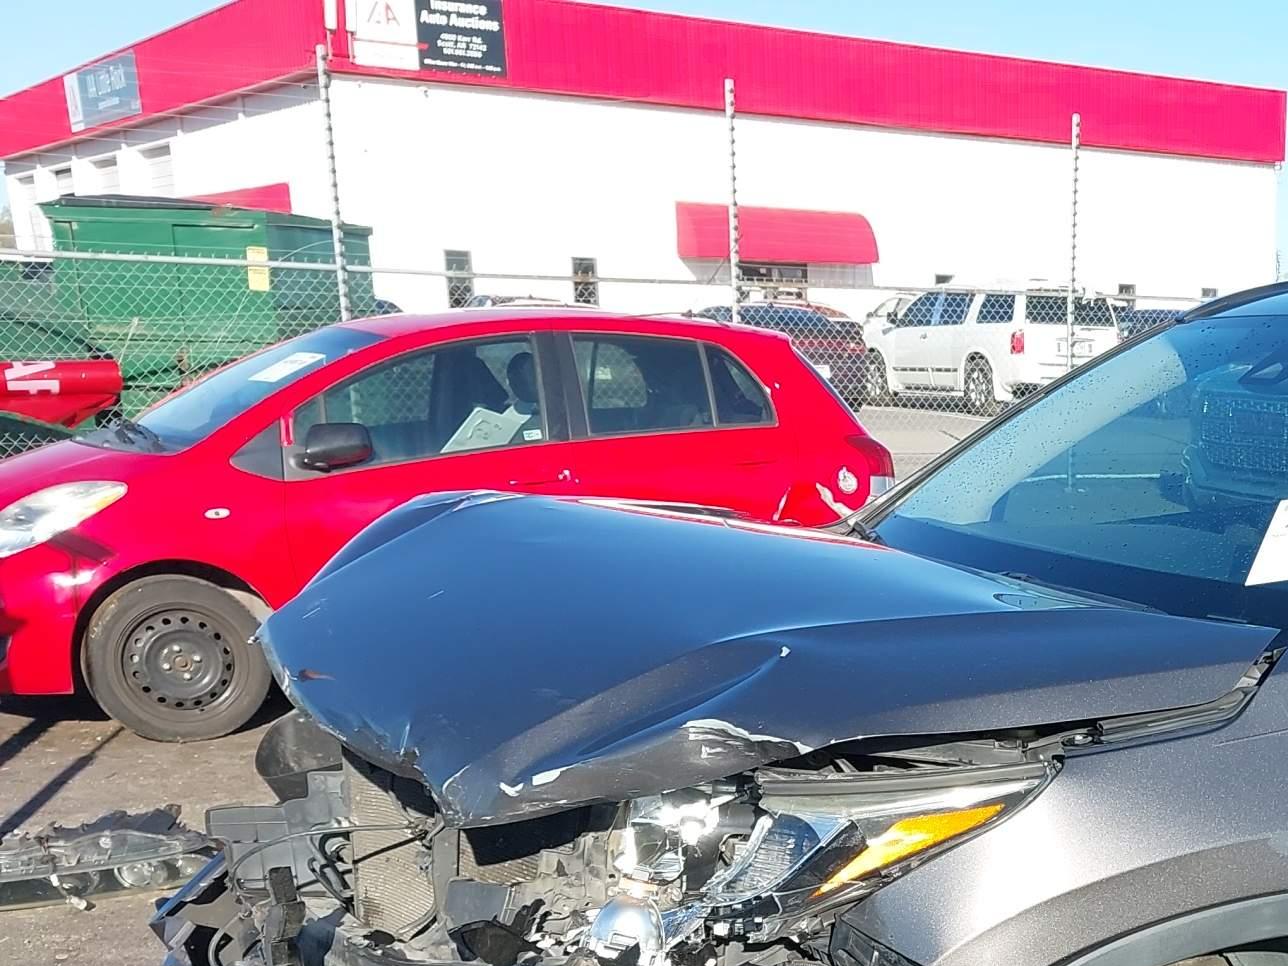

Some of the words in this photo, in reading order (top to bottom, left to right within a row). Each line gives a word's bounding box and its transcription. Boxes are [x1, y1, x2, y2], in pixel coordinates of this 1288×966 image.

[430, 0, 488, 16] Insurance
[420, 9, 448, 26] Auto
[449, 13, 500, 32] Auctions
